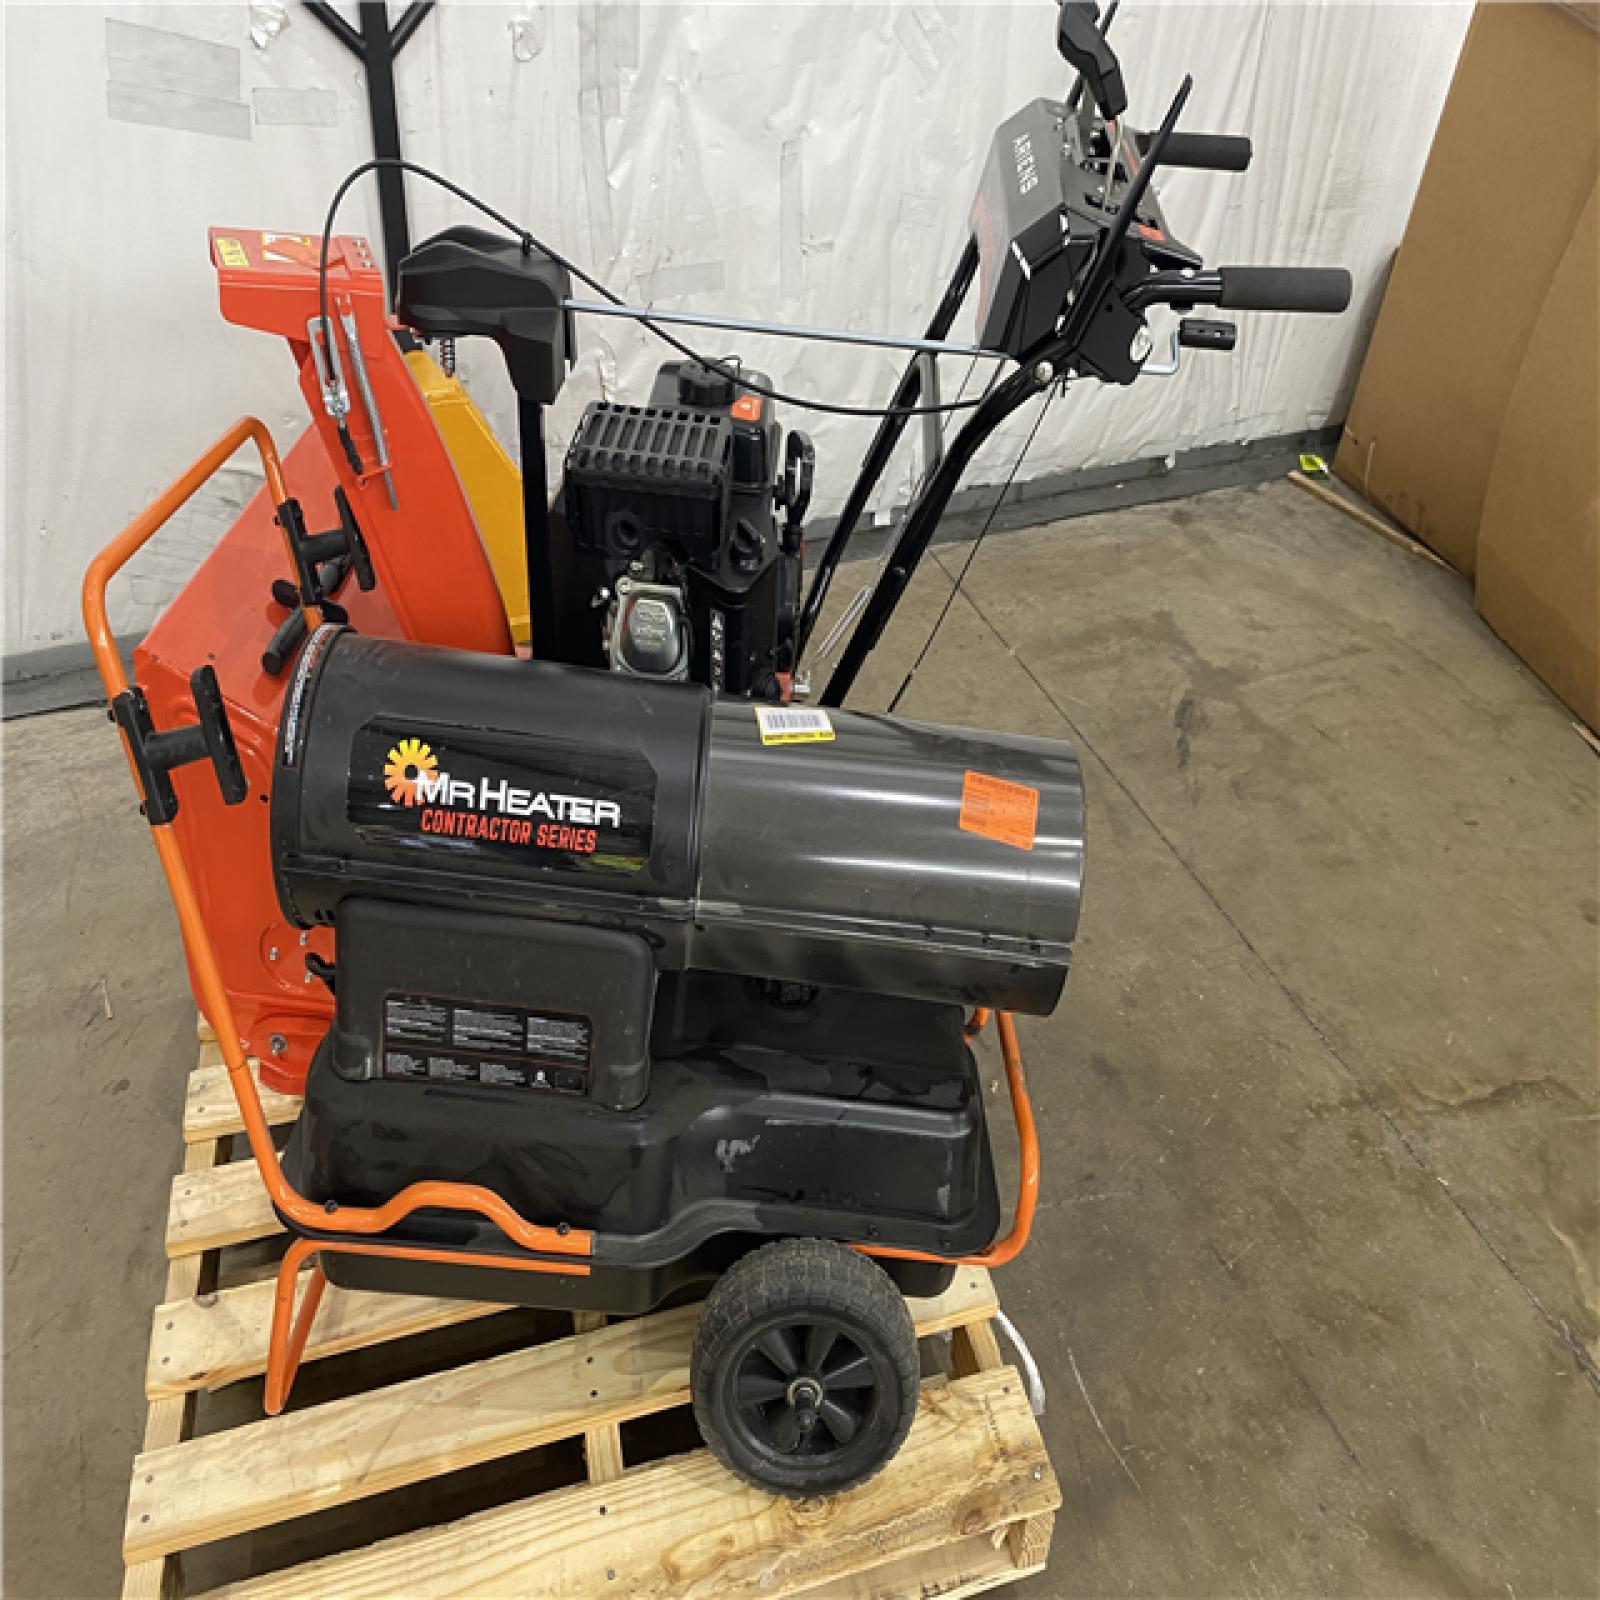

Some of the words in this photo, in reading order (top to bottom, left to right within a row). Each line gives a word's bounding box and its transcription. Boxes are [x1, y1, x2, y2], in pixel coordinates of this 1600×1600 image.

[479, 777, 621, 828] HEATER
[421, 809, 531, 844] CONTRACTOR
[536, 824, 599, 853] SERIES
